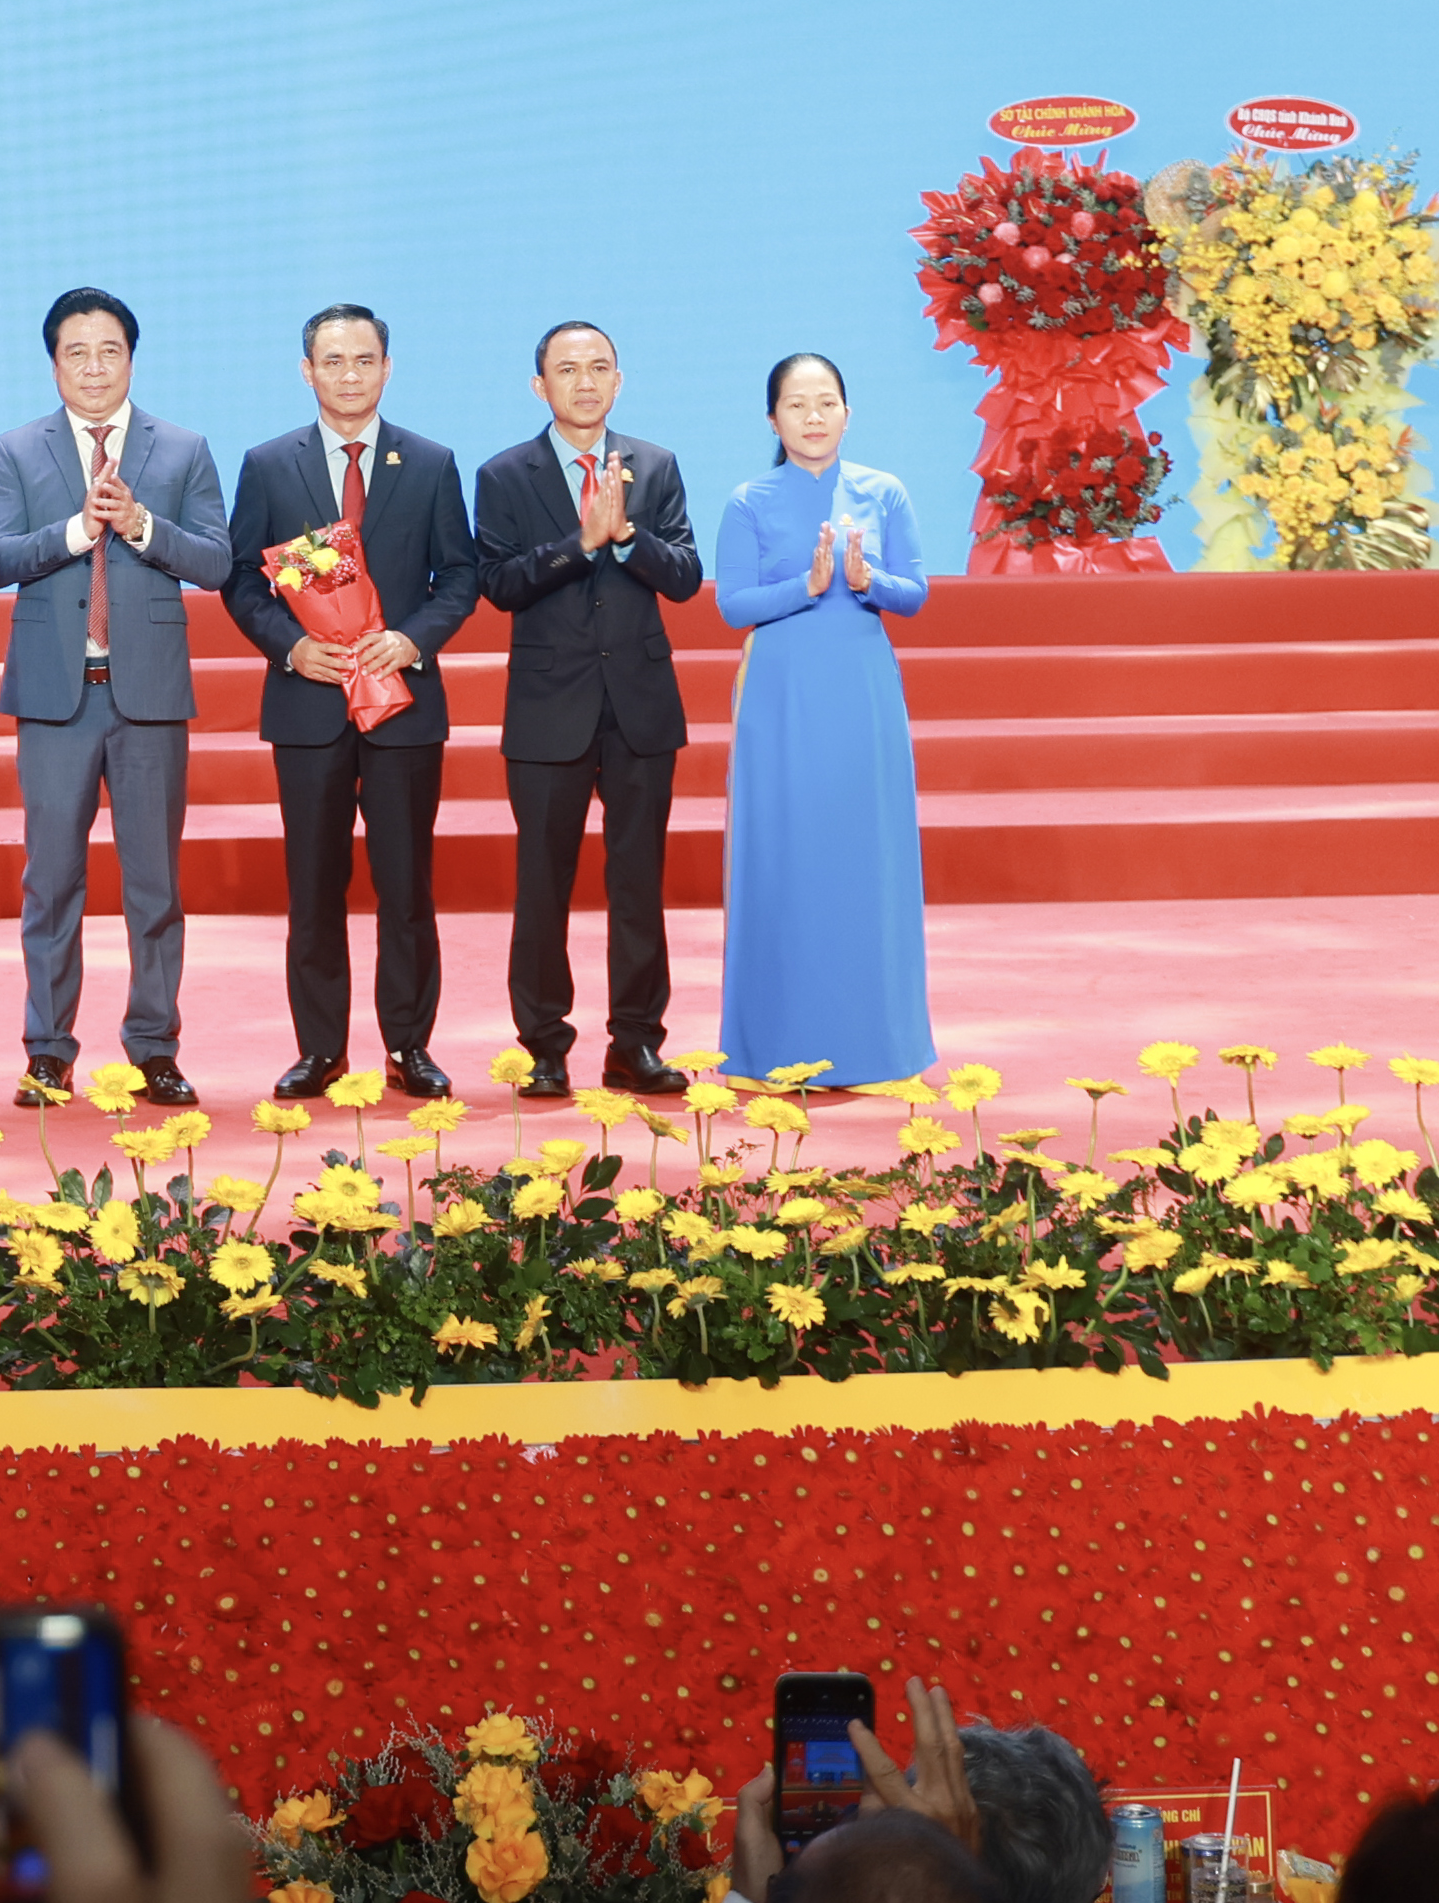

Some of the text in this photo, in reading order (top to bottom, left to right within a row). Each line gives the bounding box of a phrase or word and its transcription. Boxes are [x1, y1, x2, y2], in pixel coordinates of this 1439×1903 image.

[1011, 124, 1056, 138] Chúc
[1242, 124, 1286, 139] Chúc
[1182, 1806, 1201, 1823] CHÍ
